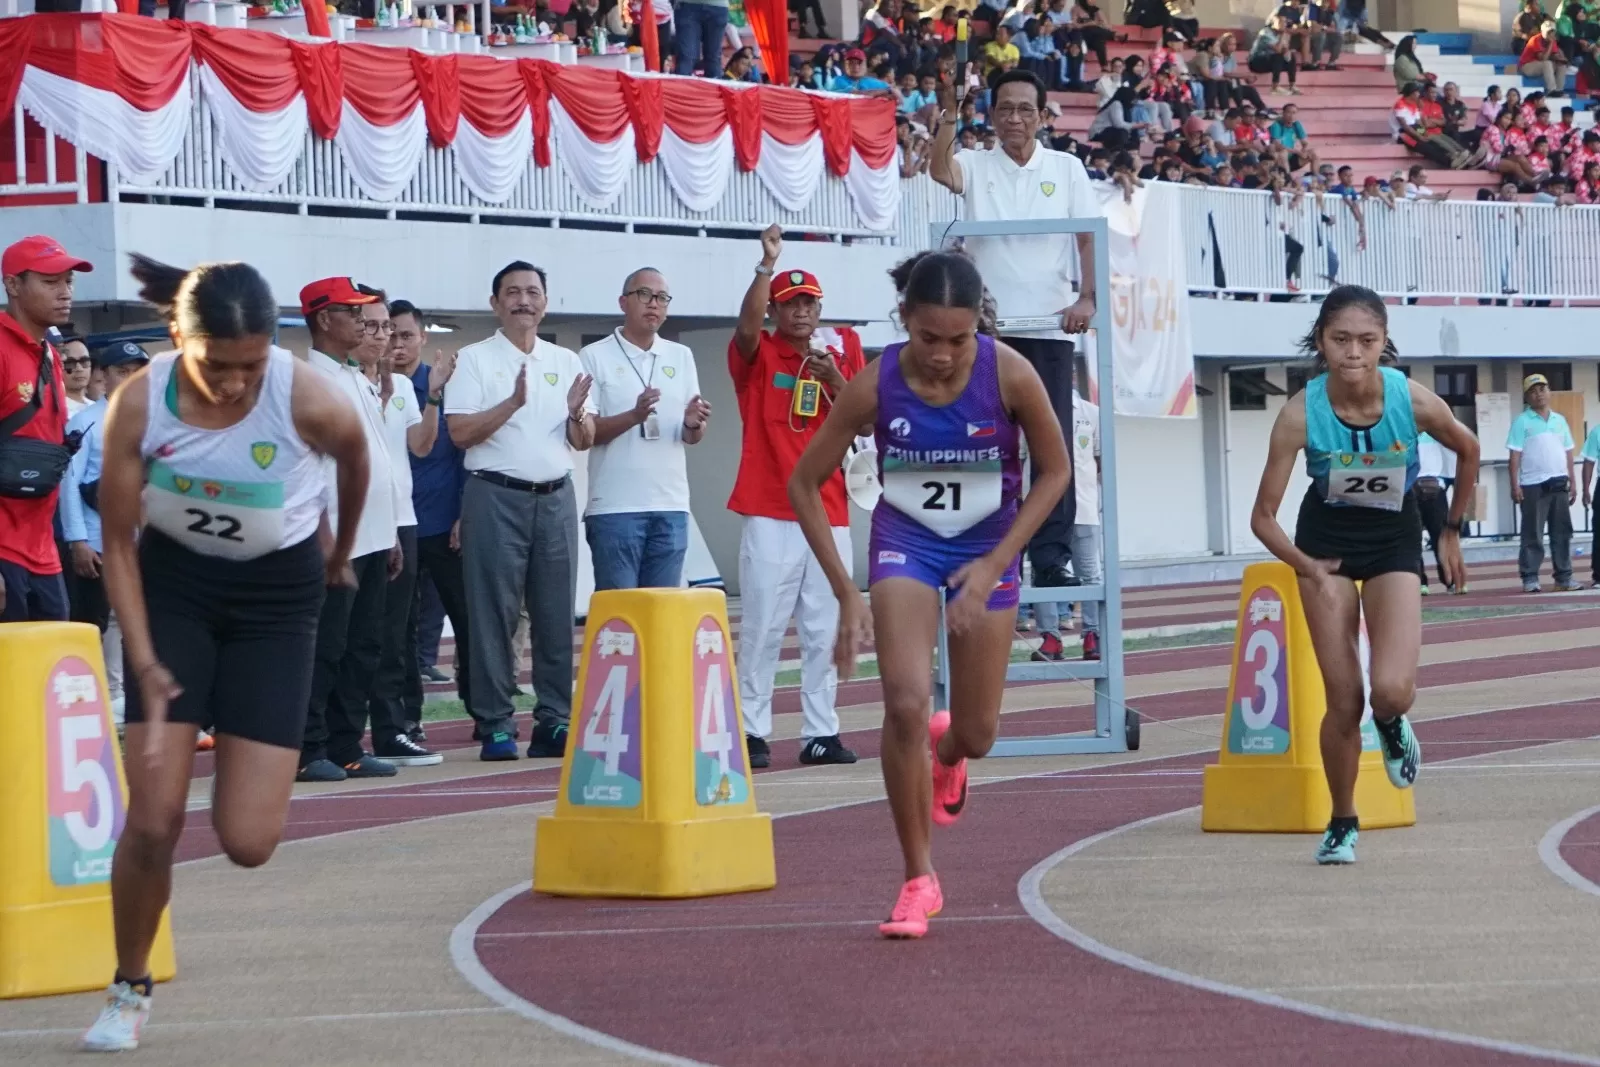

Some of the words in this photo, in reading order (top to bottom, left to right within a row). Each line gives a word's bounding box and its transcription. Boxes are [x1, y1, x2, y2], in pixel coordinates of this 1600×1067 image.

[922, 481, 961, 511] 21
[1343, 476, 1389, 493] 26
[185, 508, 245, 542] 22
[1241, 629, 1279, 730] 3
[583, 665, 629, 776] 4
[701, 664, 732, 774] 4
[1241, 736, 1275, 749] UCS
[60, 714, 114, 850] 5
[583, 785, 623, 800] UCS
